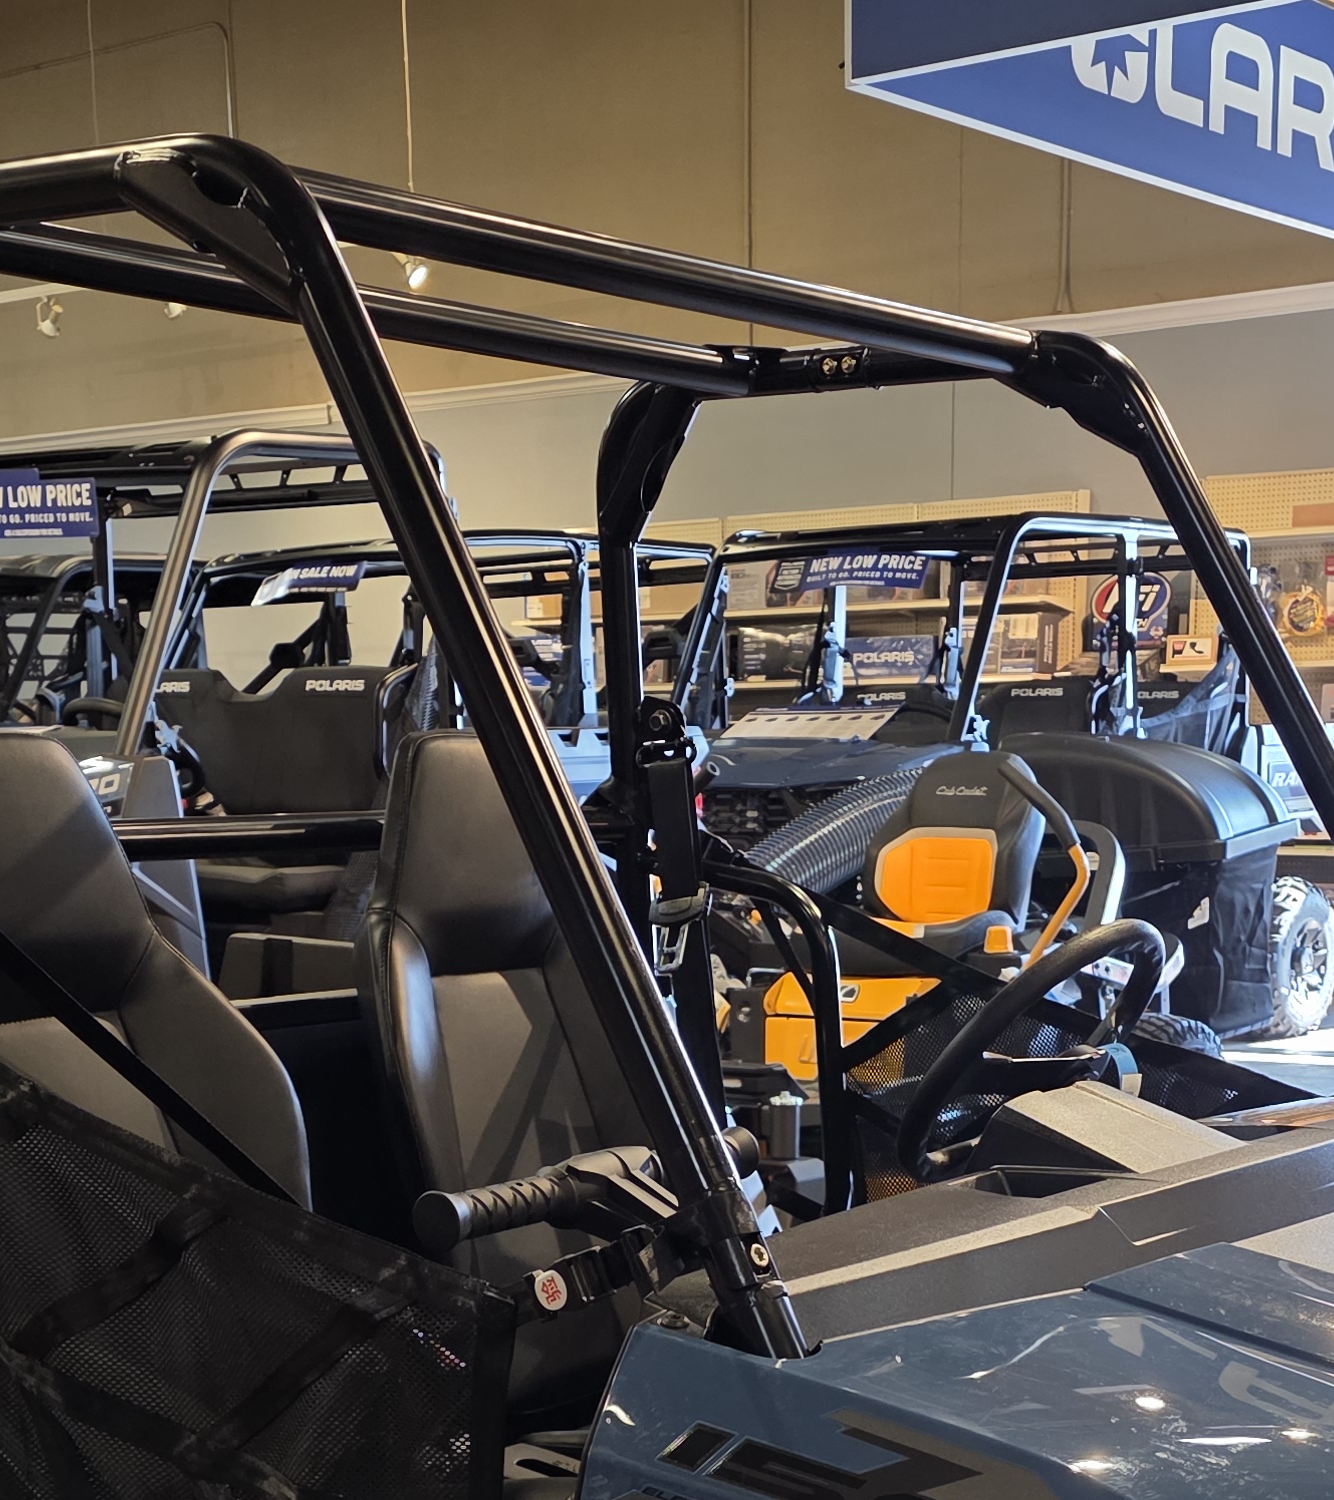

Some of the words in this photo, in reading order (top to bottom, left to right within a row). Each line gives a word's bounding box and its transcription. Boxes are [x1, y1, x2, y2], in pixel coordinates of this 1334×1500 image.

[7, 485, 42, 508] LOW
[46, 483, 92, 507] PRICE
[56, 512, 66, 522] TO
[810, 557, 843, 573] NEW
[843, 555, 876, 569] LOW
[878, 554, 925, 570] PRICE
[299, 566, 331, 579] SALE
[329, 565, 358, 577] NOW
[853, 651, 915, 663] POLARIS
[305, 680, 365, 691] POLARIS
[1011, 687, 1064, 697] POLARIS
[1137, 690, 1179, 699] OLARIS
